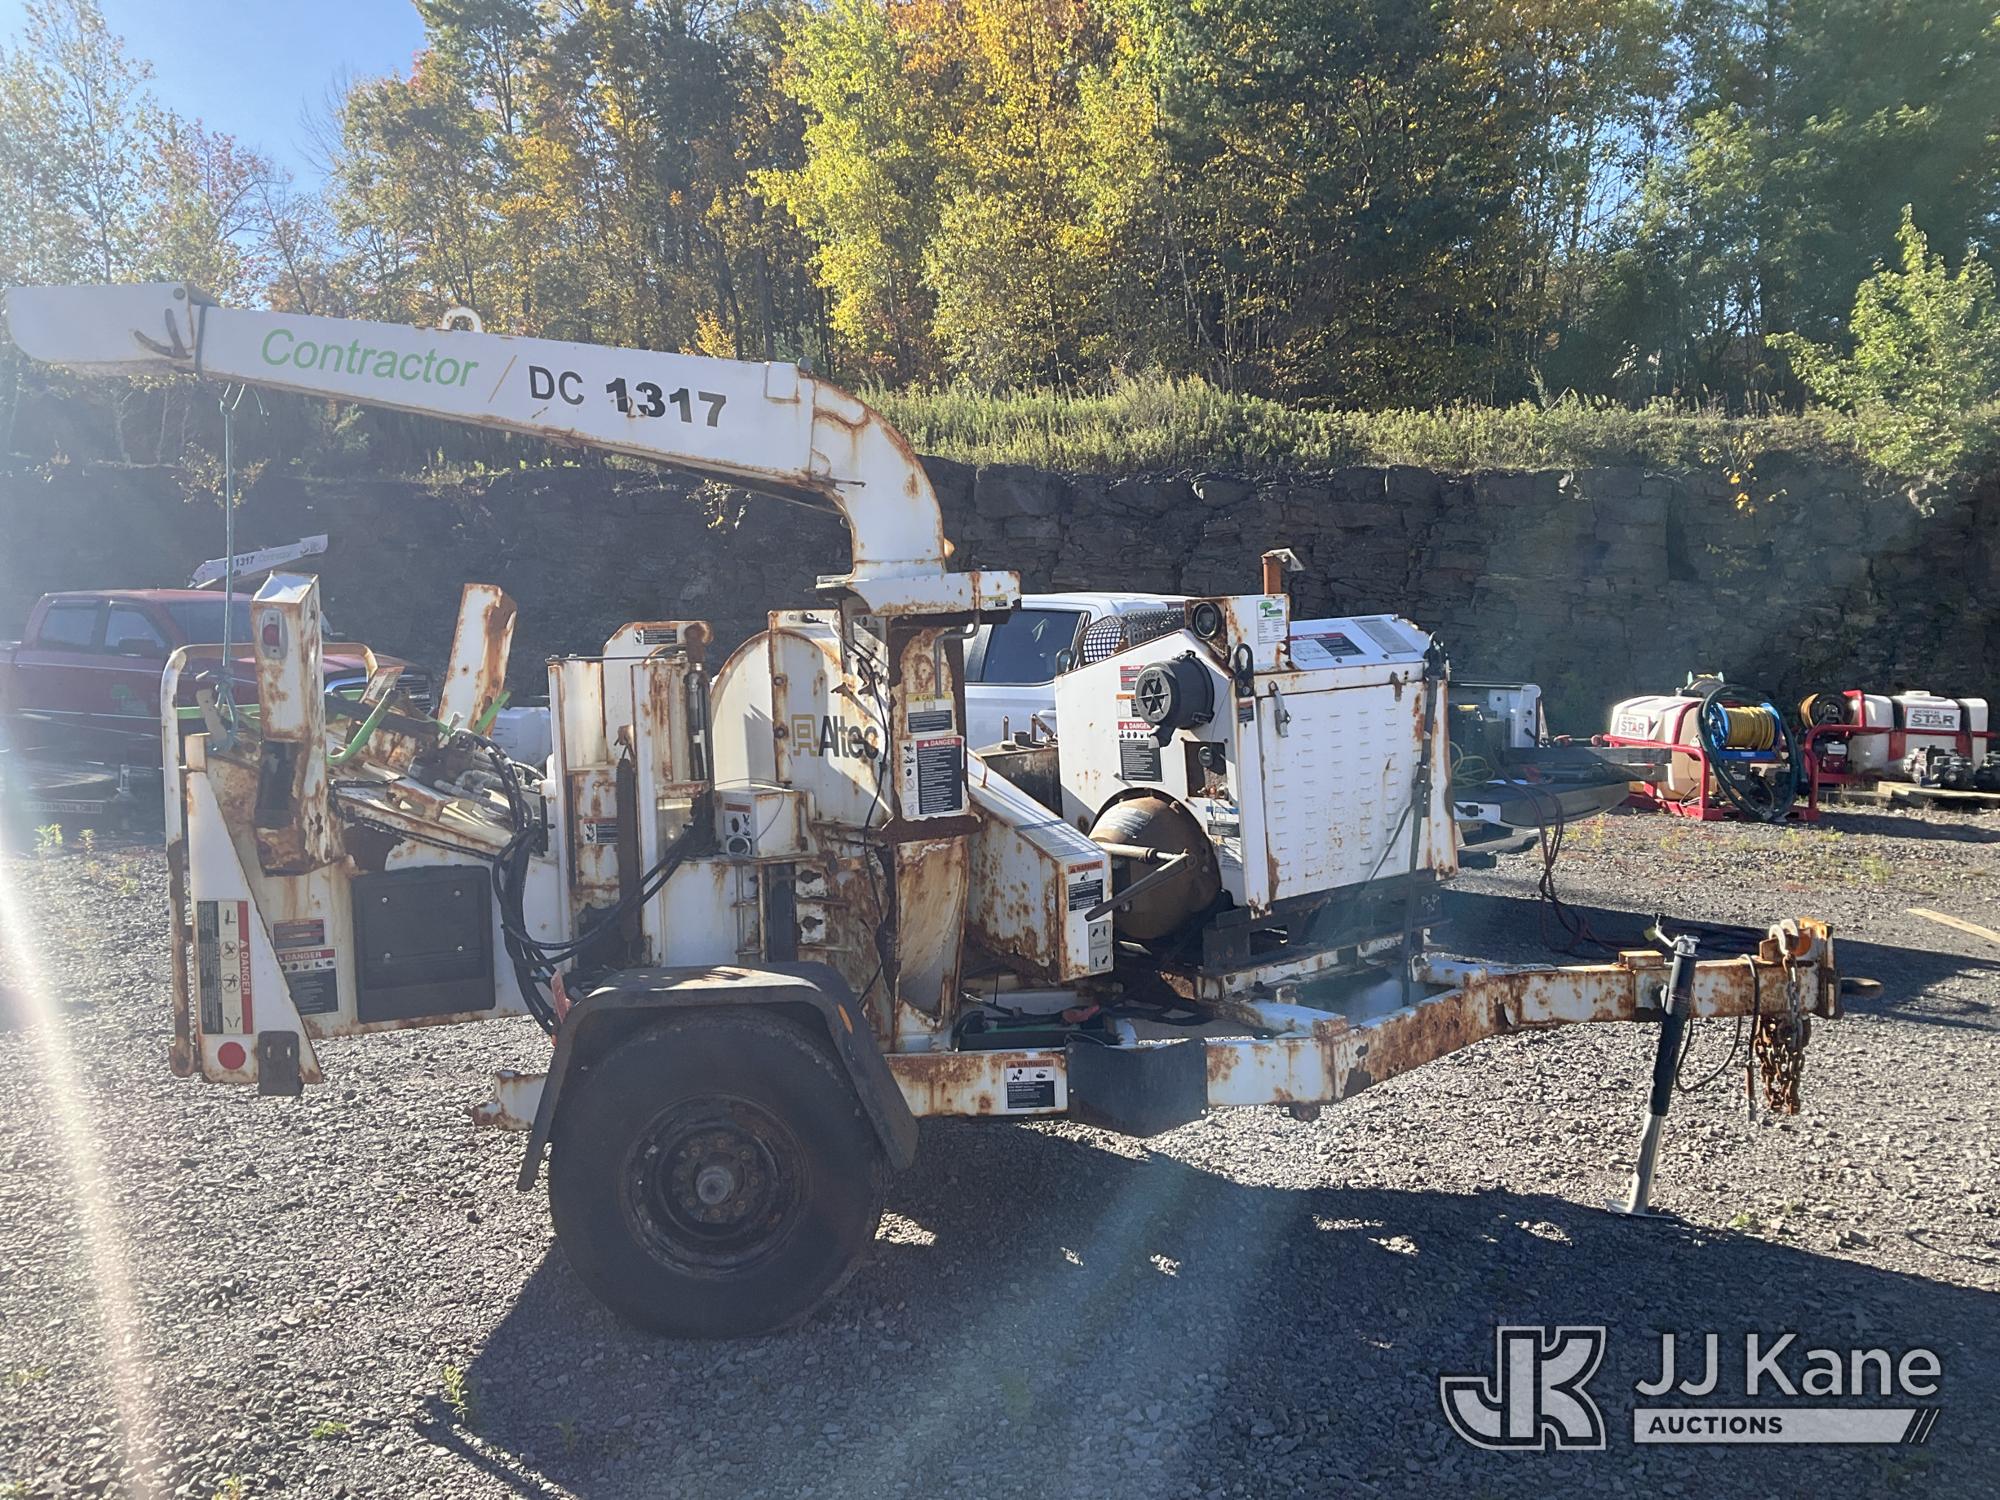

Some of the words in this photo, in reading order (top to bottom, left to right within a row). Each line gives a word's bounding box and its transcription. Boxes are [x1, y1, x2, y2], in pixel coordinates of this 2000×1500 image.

[261, 328, 479, 387] Contractor
[528, 365, 585, 406] DC
[605, 377, 727, 428] 1317
[1911, 713, 1954, 724] STAR
[1620, 720, 1645, 732] STAR
[818, 714, 880, 760] Altec
[929, 738, 956, 746] DANGER
[284, 951, 322, 961] DANGER
[240, 951, 250, 995] DANGER
